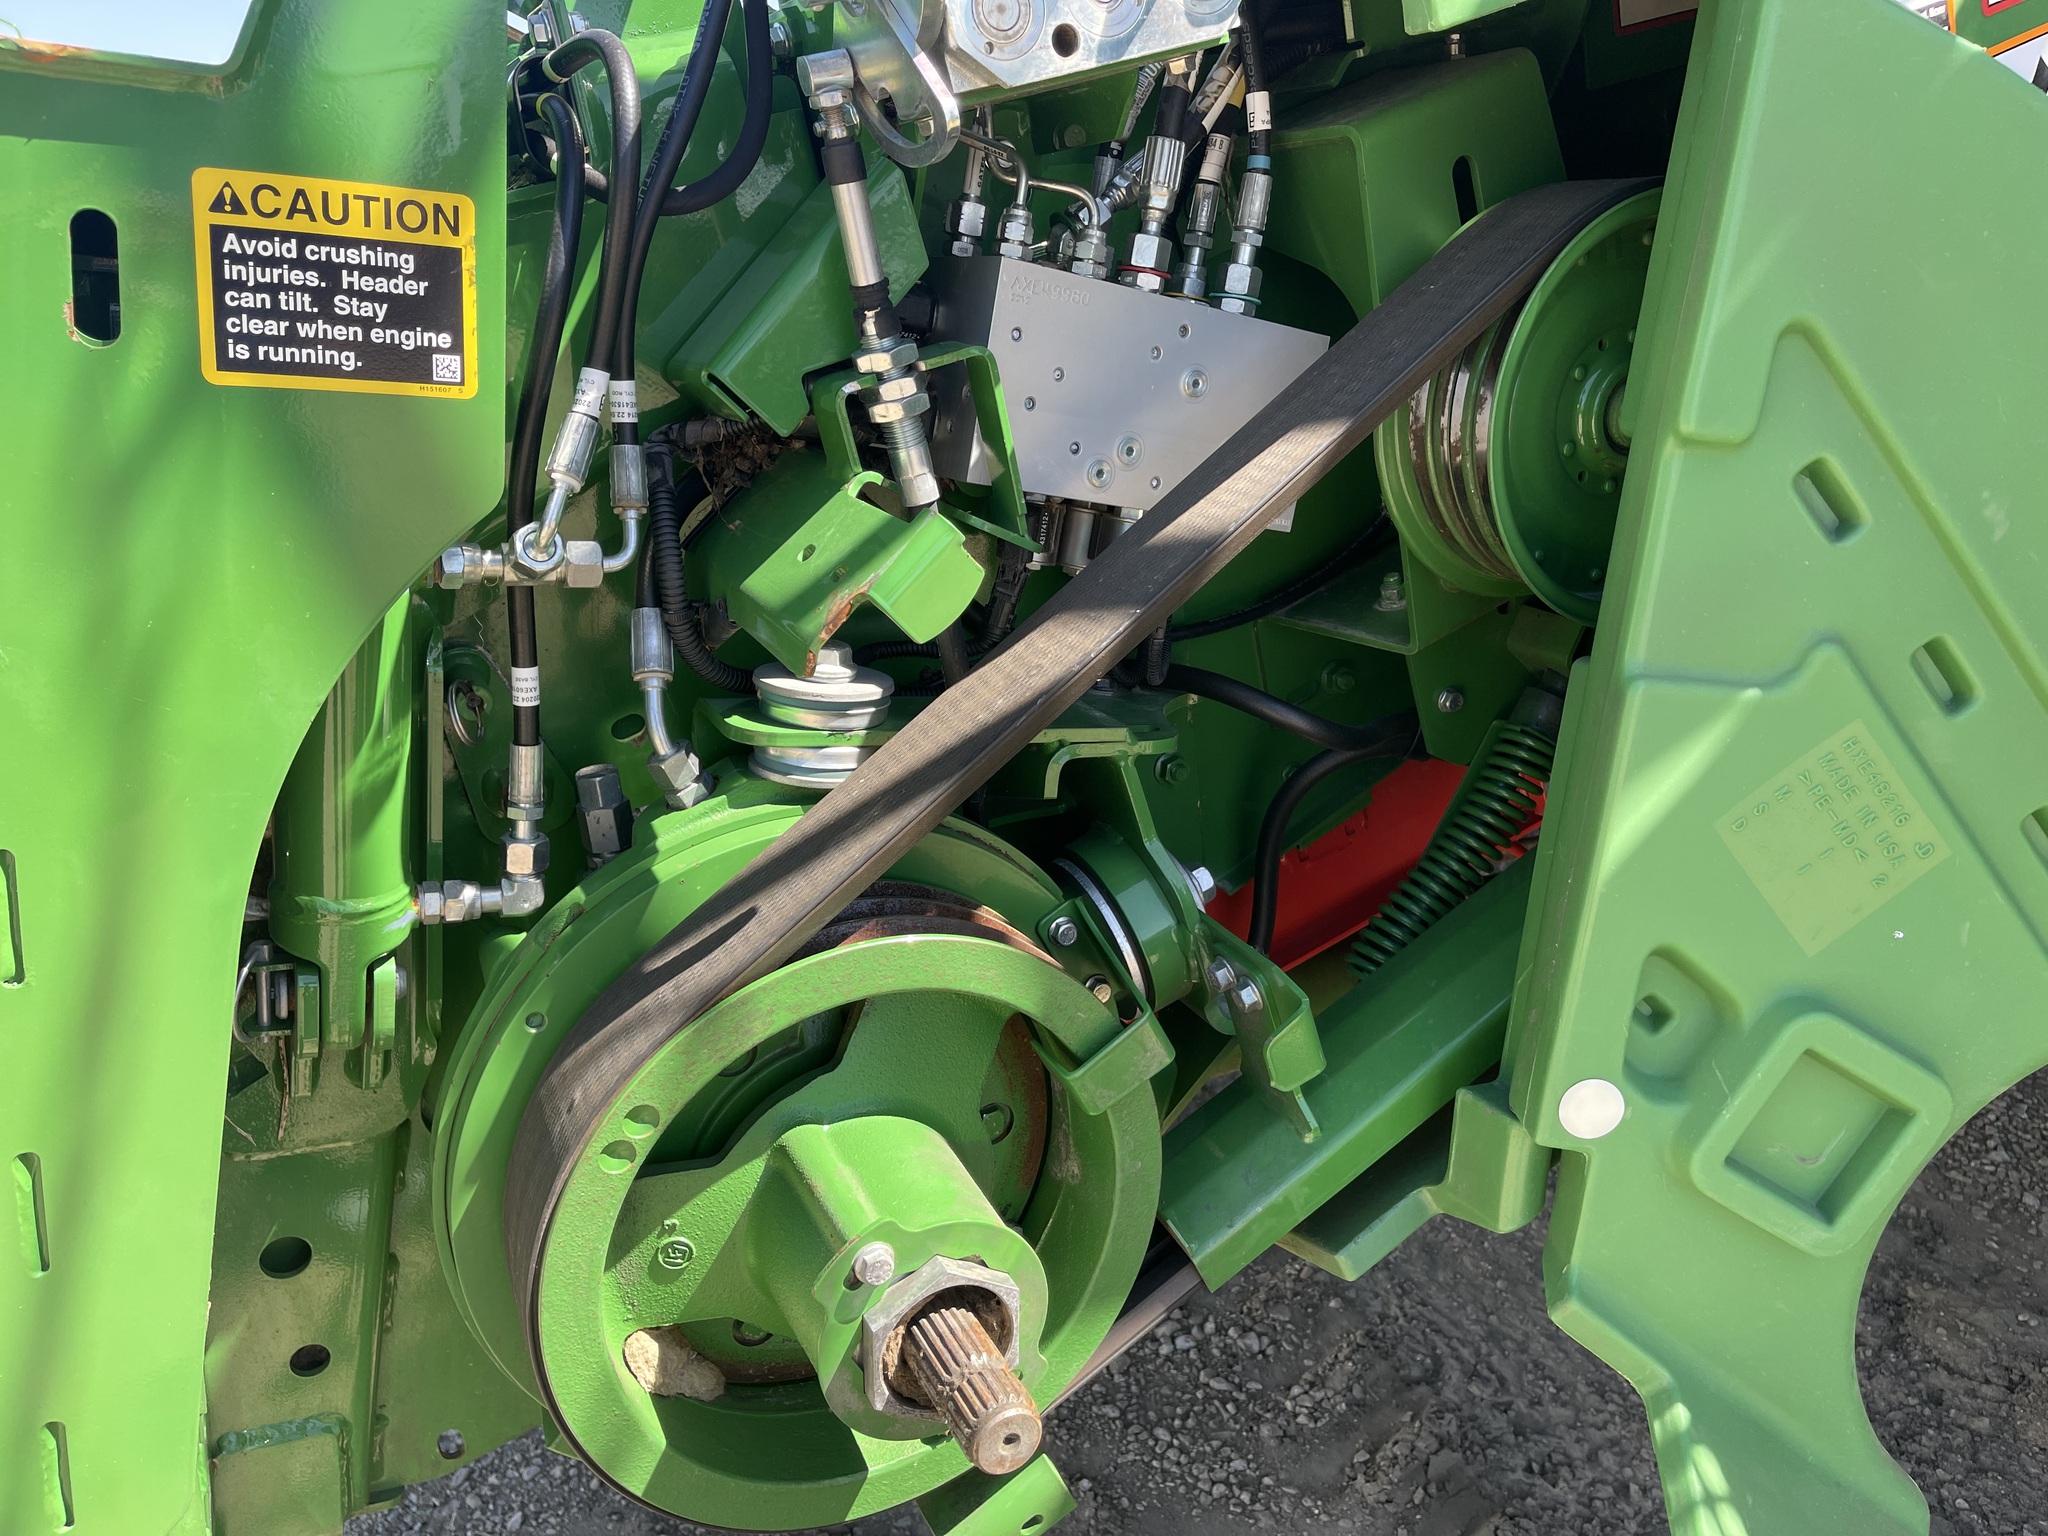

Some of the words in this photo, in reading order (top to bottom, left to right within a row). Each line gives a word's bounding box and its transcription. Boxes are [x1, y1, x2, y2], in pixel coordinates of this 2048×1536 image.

[249, 184, 461, 237] CAUTION
[222, 233, 297, 259] Avoid
[305, 243, 415, 274] crushing
[223, 259, 327, 288] injuries.
[341, 270, 428, 297] Header
[224, 290, 271, 310] can
[278, 290, 319, 313] tilt.
[333, 295, 388, 322] Stay
[226, 314, 289, 337] clear
[296, 319, 362, 342] when
[370, 328, 452, 350] engine
[227, 339, 250, 360] is
[257, 343, 362, 371] running.
[419, 385, 452, 394] H151607
[1774, 784, 1793, 803] M
[1841, 736, 1912, 827] HXE48216
[1730, 816, 1747, 833] D
[1753, 803, 1769, 816] S
[1818, 753, 1862, 802] MADE
[1855, 805, 1879, 830] IN
[1875, 831, 1907, 870] USA
